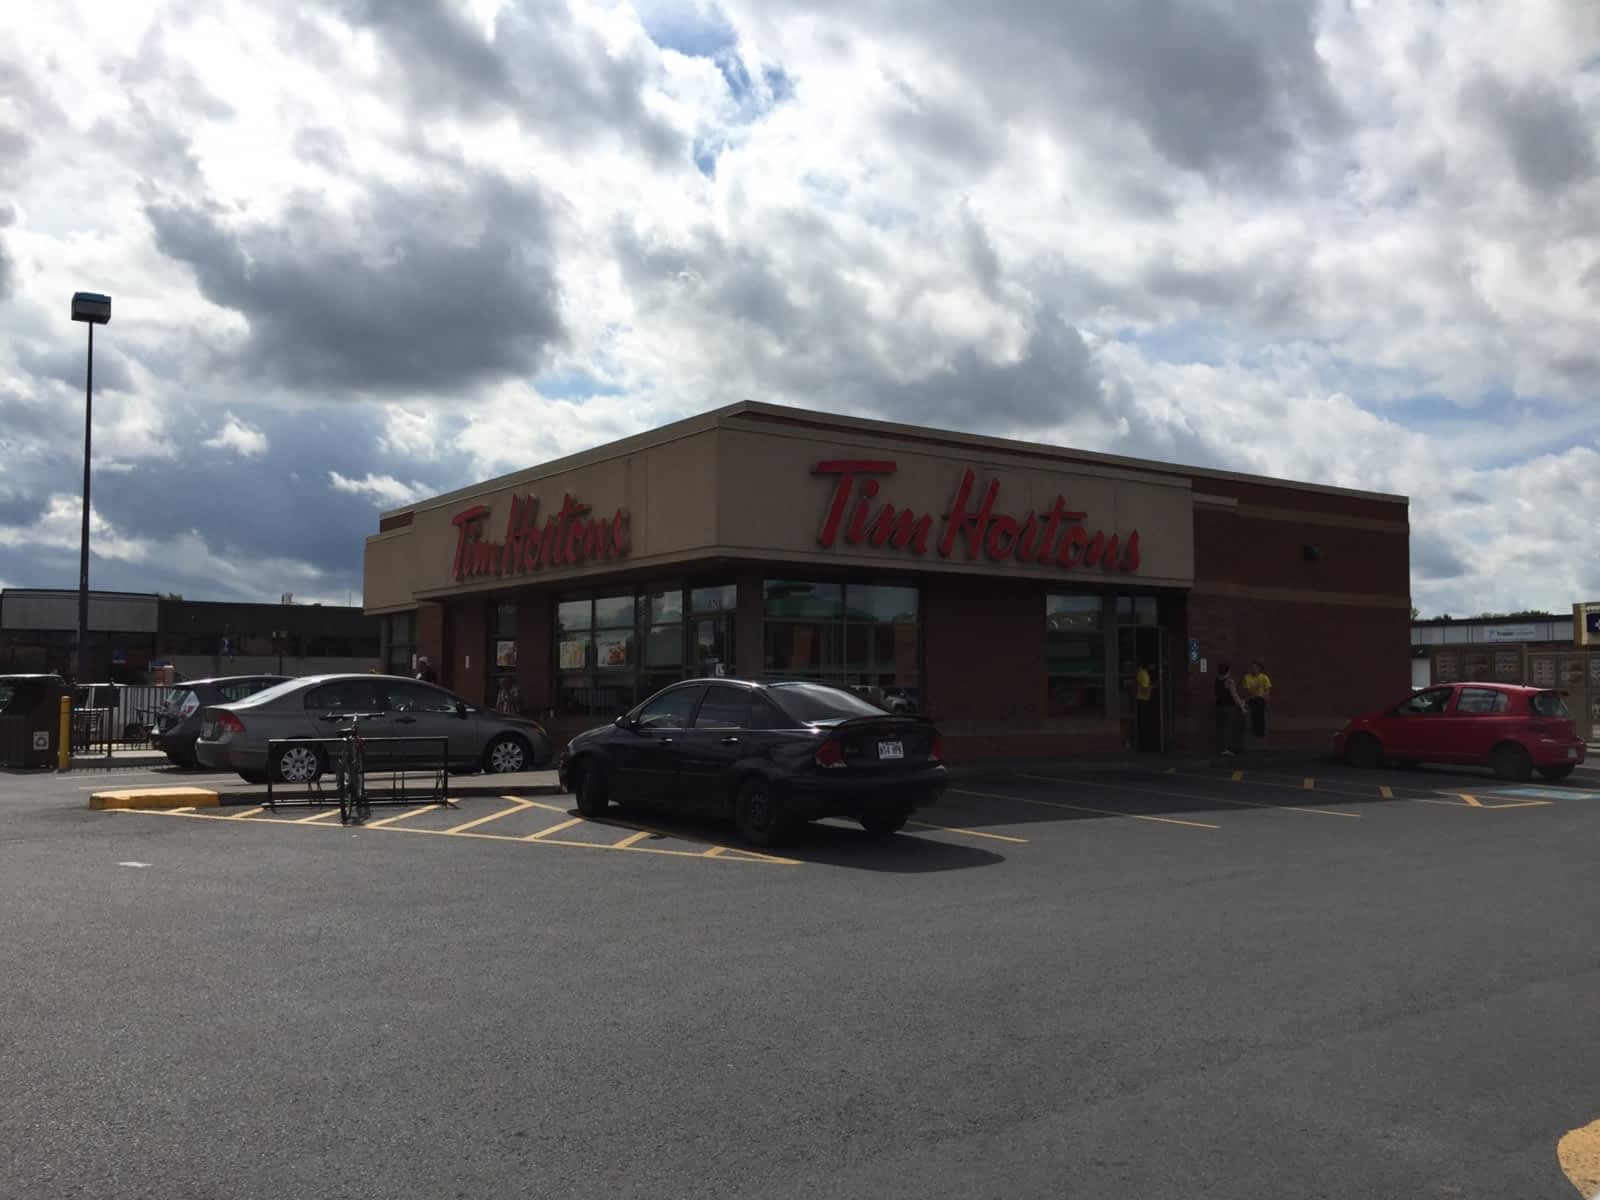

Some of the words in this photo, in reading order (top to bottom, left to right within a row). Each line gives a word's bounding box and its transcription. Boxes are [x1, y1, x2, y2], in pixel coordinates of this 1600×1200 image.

[452, 504, 500, 578] Tim
[501, 493, 627, 573] Hortons
[813, 460, 932, 555] Tim
[939, 467, 1141, 571] Hortons
